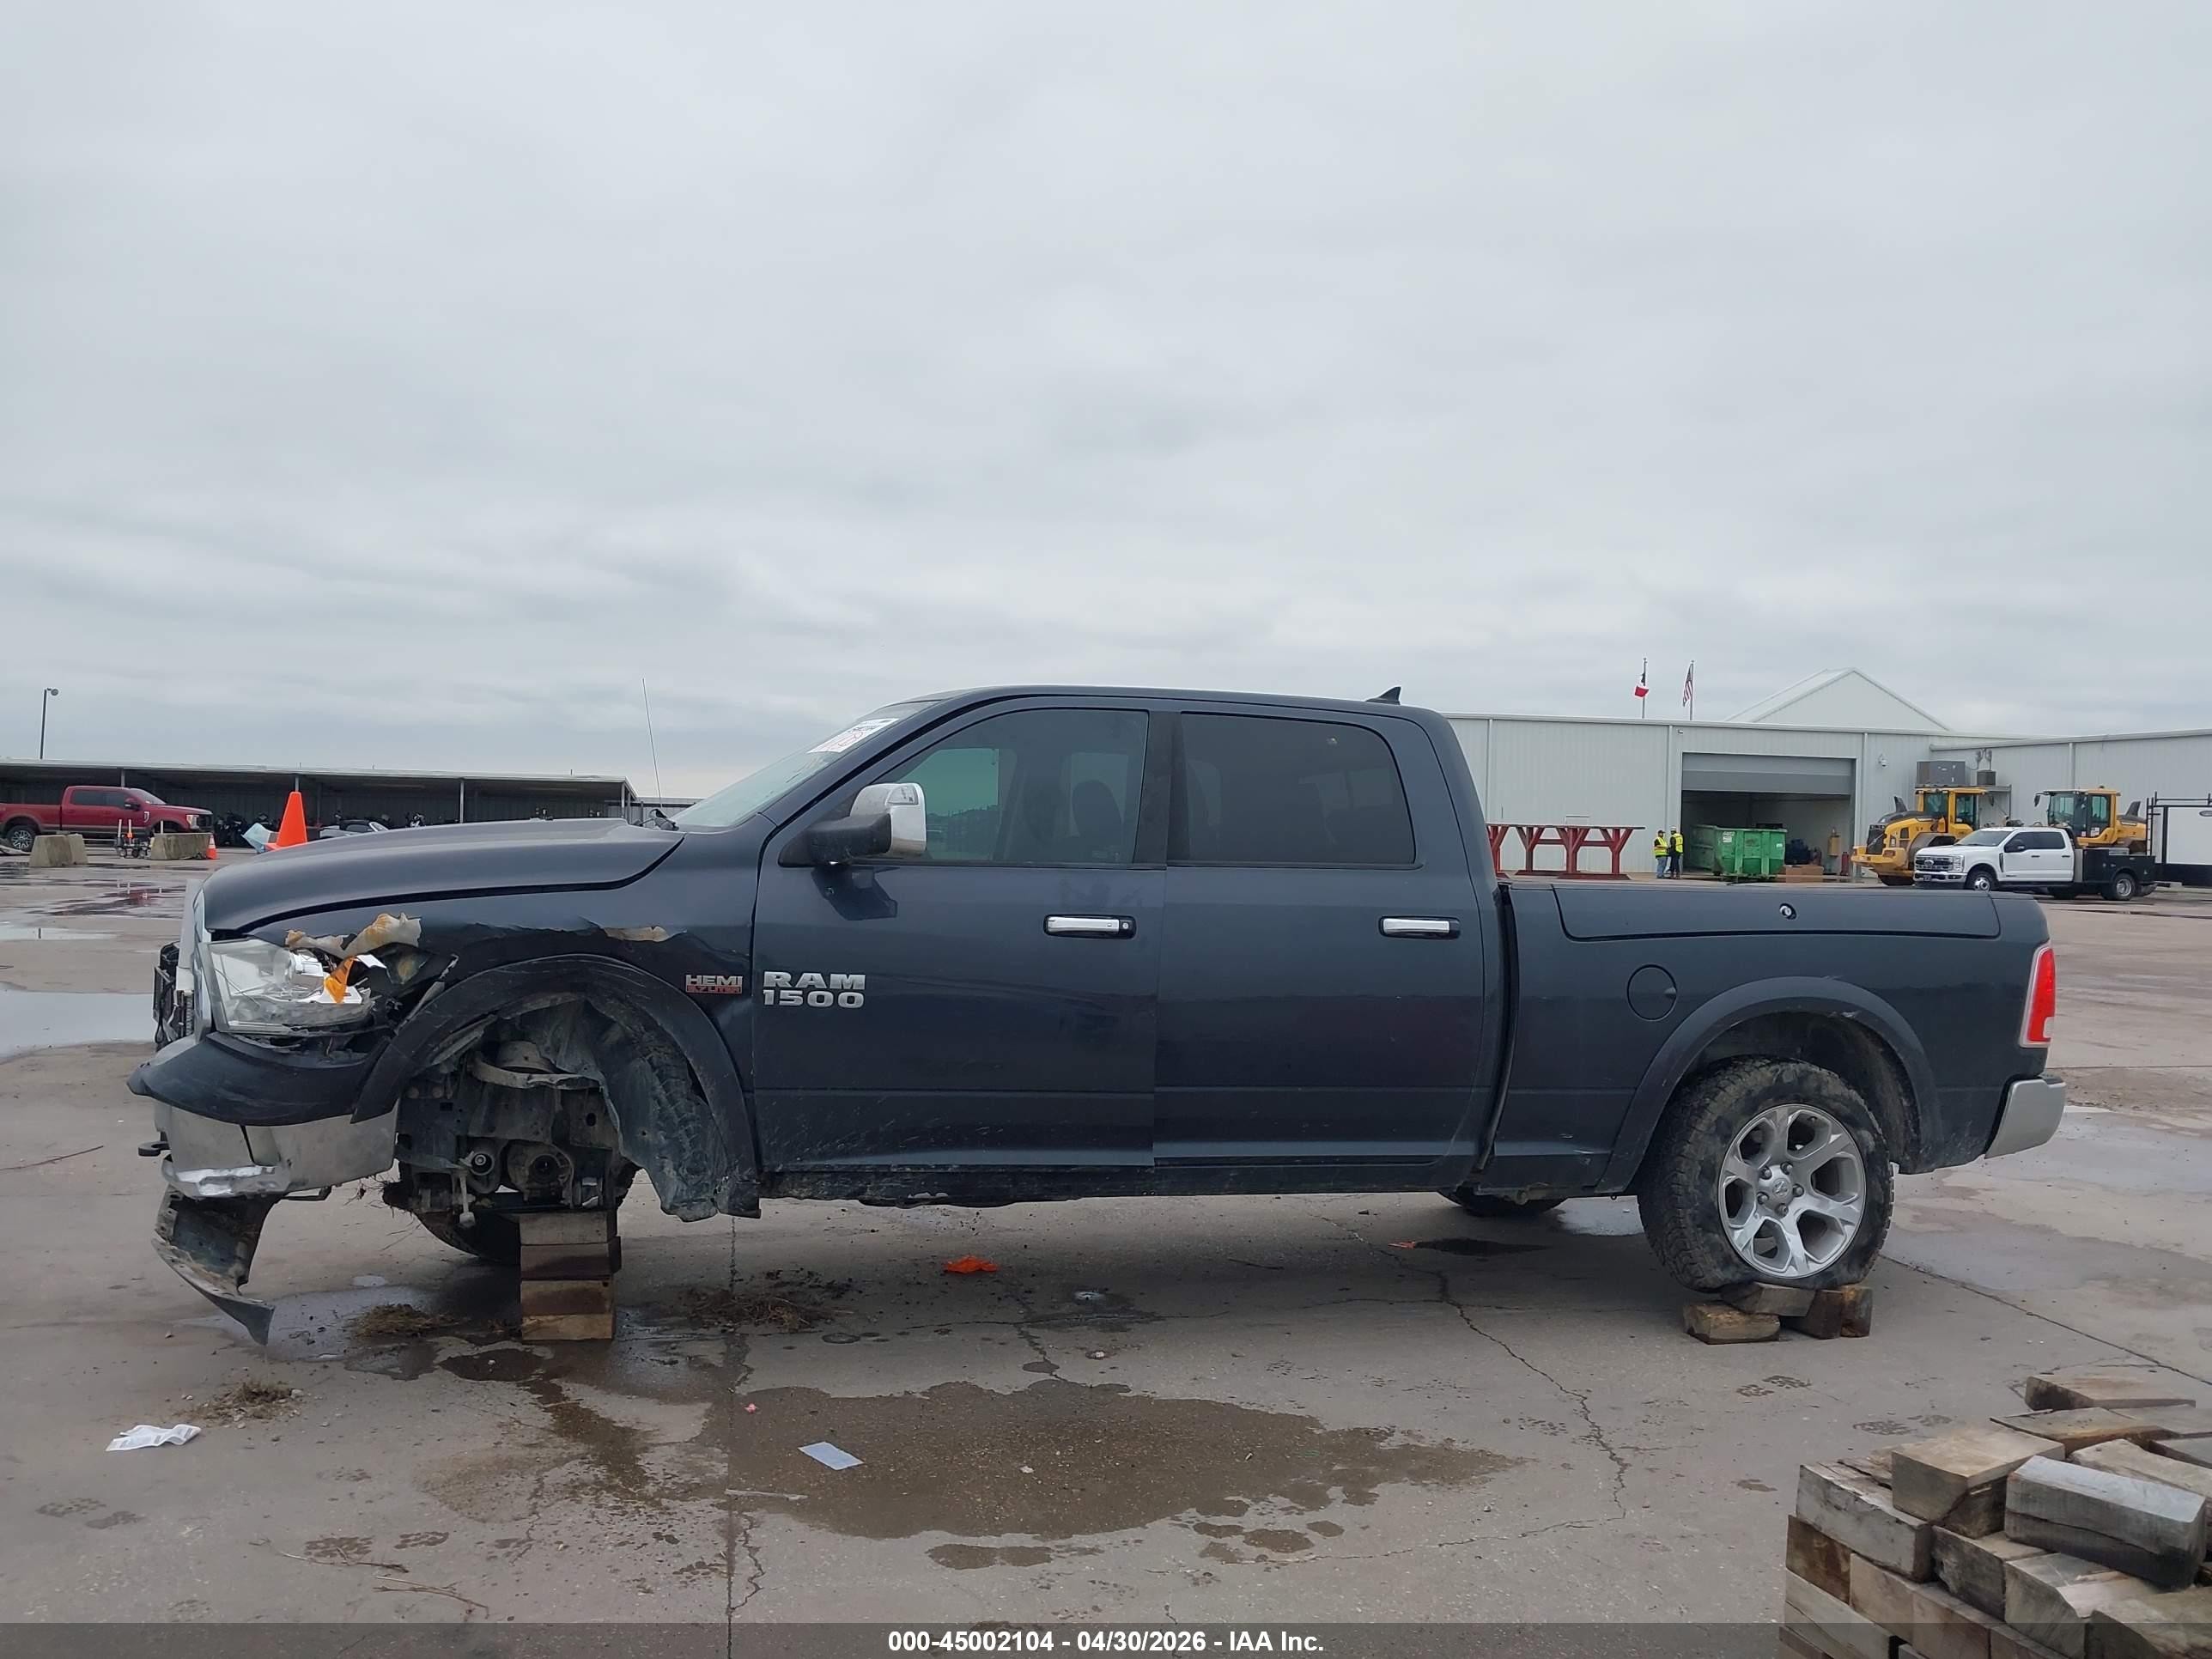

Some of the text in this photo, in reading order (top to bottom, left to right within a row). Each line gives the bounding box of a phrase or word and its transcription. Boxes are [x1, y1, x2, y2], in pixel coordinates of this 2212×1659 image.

[686, 975, 743, 985] HEMI
[763, 971, 866, 990] RAM
[763, 990, 864, 1008] 1500
